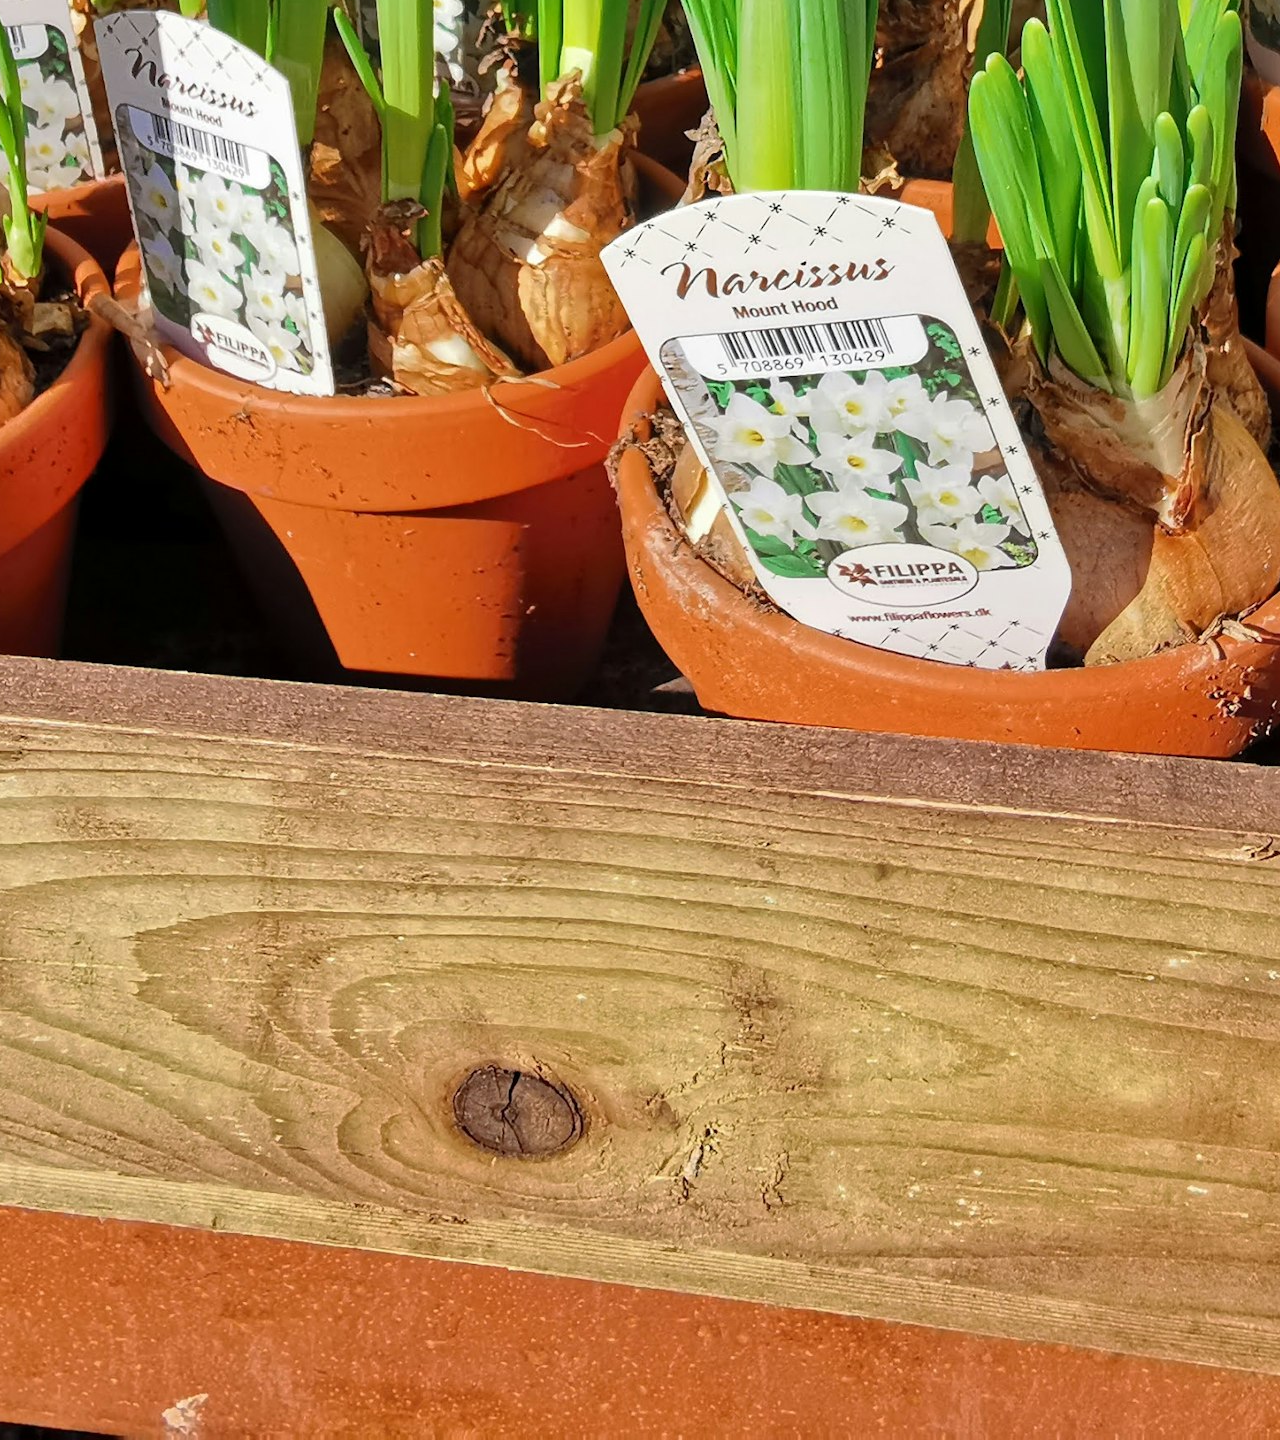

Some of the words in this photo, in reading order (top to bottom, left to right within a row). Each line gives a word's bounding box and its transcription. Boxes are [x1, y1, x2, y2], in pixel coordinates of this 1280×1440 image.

[124, 47, 260, 117] Narcissus
[196, 110, 224, 129] Hood
[659, 258, 896, 300] Narcissus
[731, 301, 790, 320] Mount
[791, 296, 840, 314] Hood
[216, 331, 270, 364] FILIPPA
[716, 363, 729, 376] 5
[740, 357, 805, 373] 708869
[819, 349, 886, 368] 130429
[873, 561, 965, 578] FILIPPA
[847, 607, 993, 623] www.filippaflowers.dk
